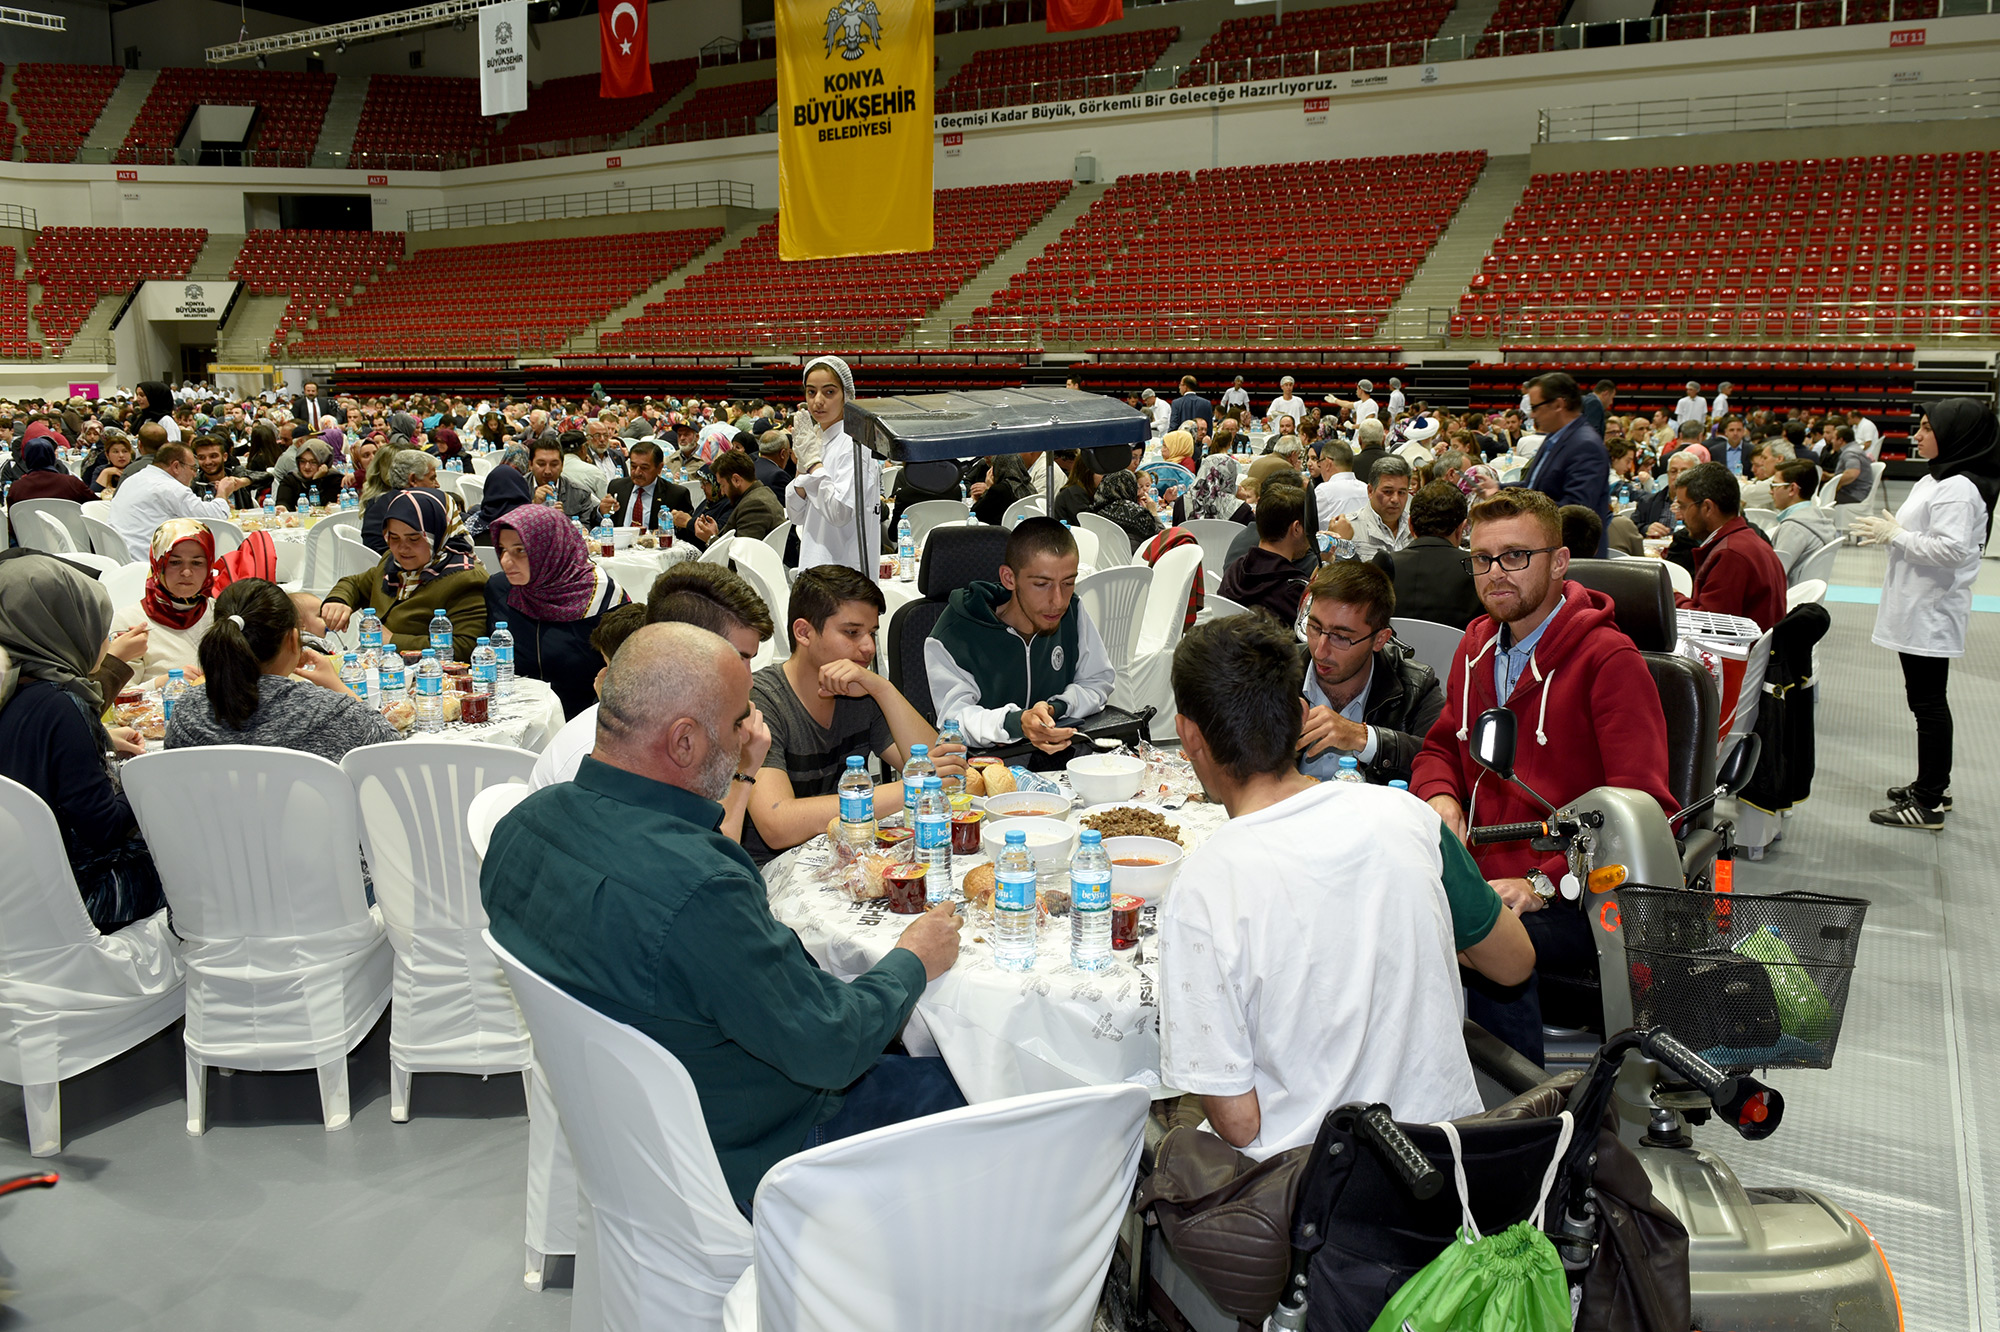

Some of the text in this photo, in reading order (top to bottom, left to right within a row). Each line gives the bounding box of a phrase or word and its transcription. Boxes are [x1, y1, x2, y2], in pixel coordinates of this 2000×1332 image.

[1891, 32, 1924, 44] ALT 11
[495, 47, 514, 56] KONYA
[824, 68, 884, 93] KONYA
[794, 85, 916, 126] BÜYÜKŞEHİR
[941, 112, 988, 128] Geçmişi
[991, 109, 1028, 123] Kadar
[1031, 104, 1076, 119] Büyük,
[1079, 96, 1141, 114] Görkemli
[1145, 94, 1166, 107] Bir
[1169, 87, 1235, 104] Geleceğe
[1239, 79, 1337, 98] Hazırlıyoruz.
[1305, 100, 1329, 110] ALT 10
[818, 117, 891, 142] BELEDİYESİ
[945, 136, 956, 144] ALT
[1082, 889, 1105, 901] beysu
